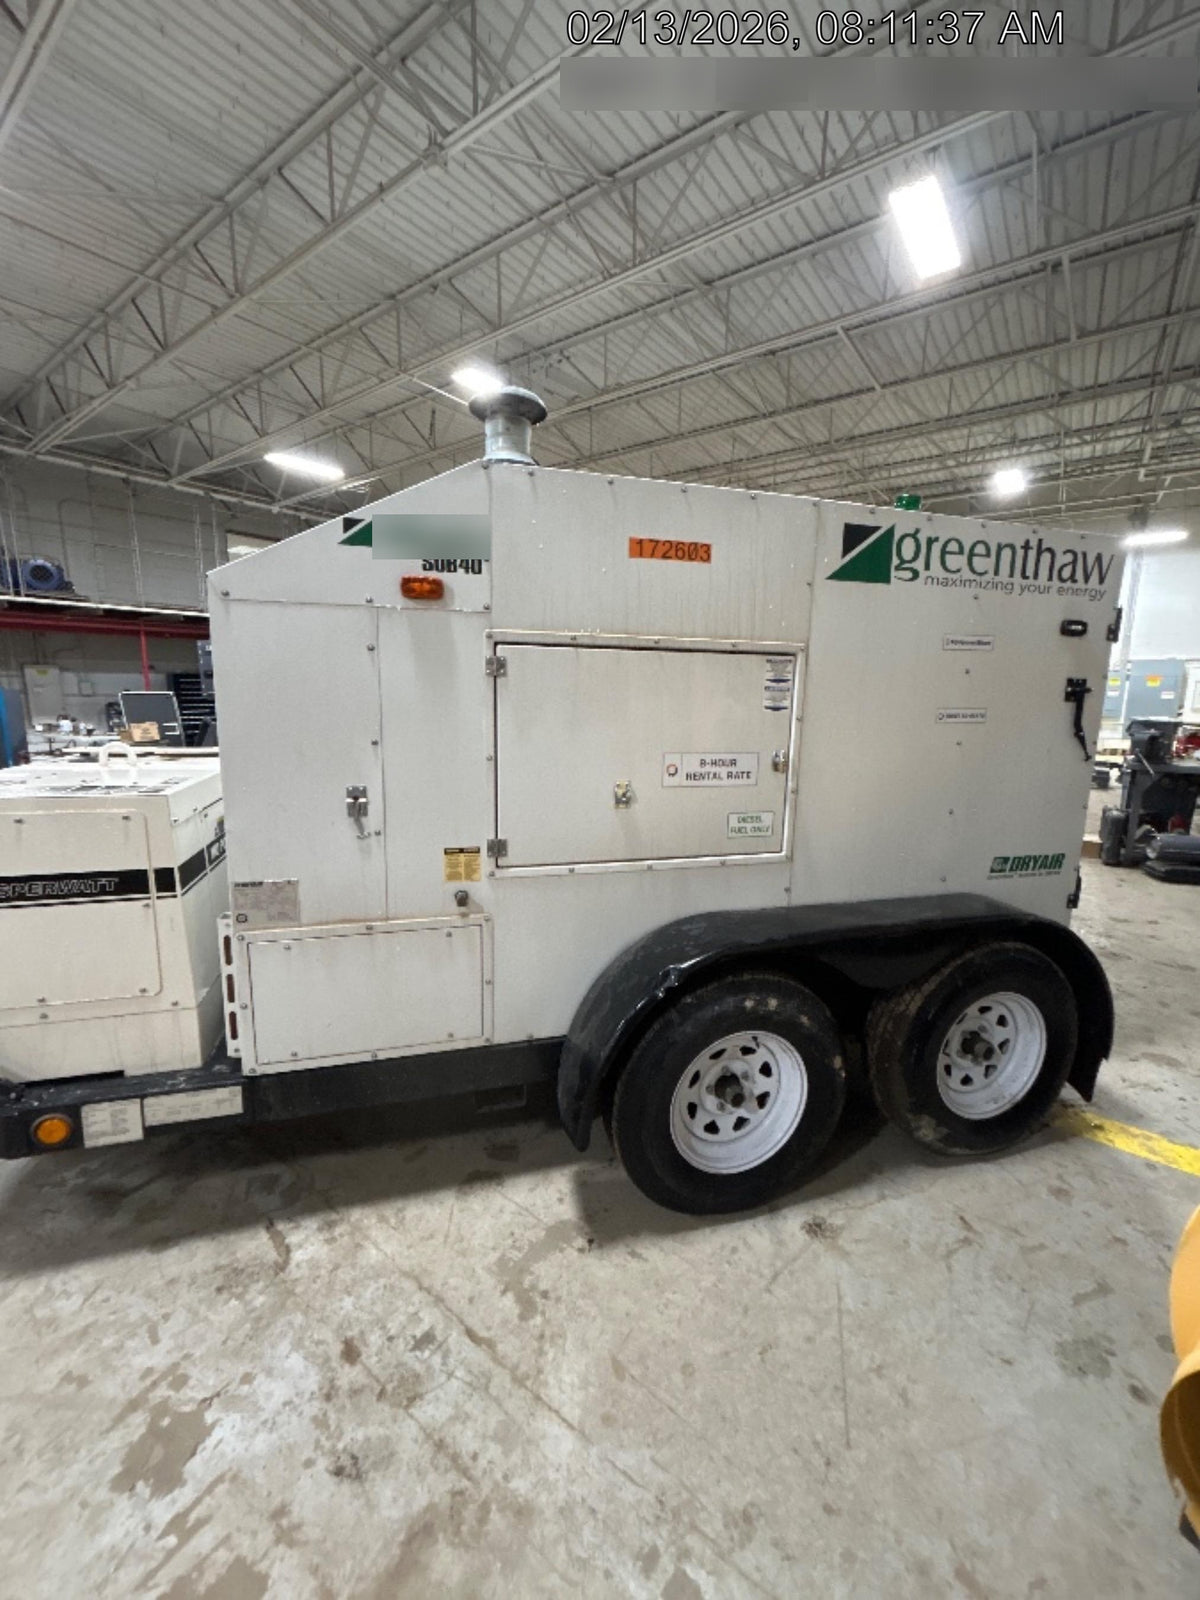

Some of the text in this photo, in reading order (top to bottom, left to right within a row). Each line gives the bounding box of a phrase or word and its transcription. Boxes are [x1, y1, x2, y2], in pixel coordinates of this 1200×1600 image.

[635, 538, 711, 562] 172603
[894, 528, 1115, 585] greenthaw
[924, 575, 1107, 601] maximizing your energy
[686, 771, 752, 781] RENTAL RATE
[1008, 853, 1065, 872] DRYAIR
